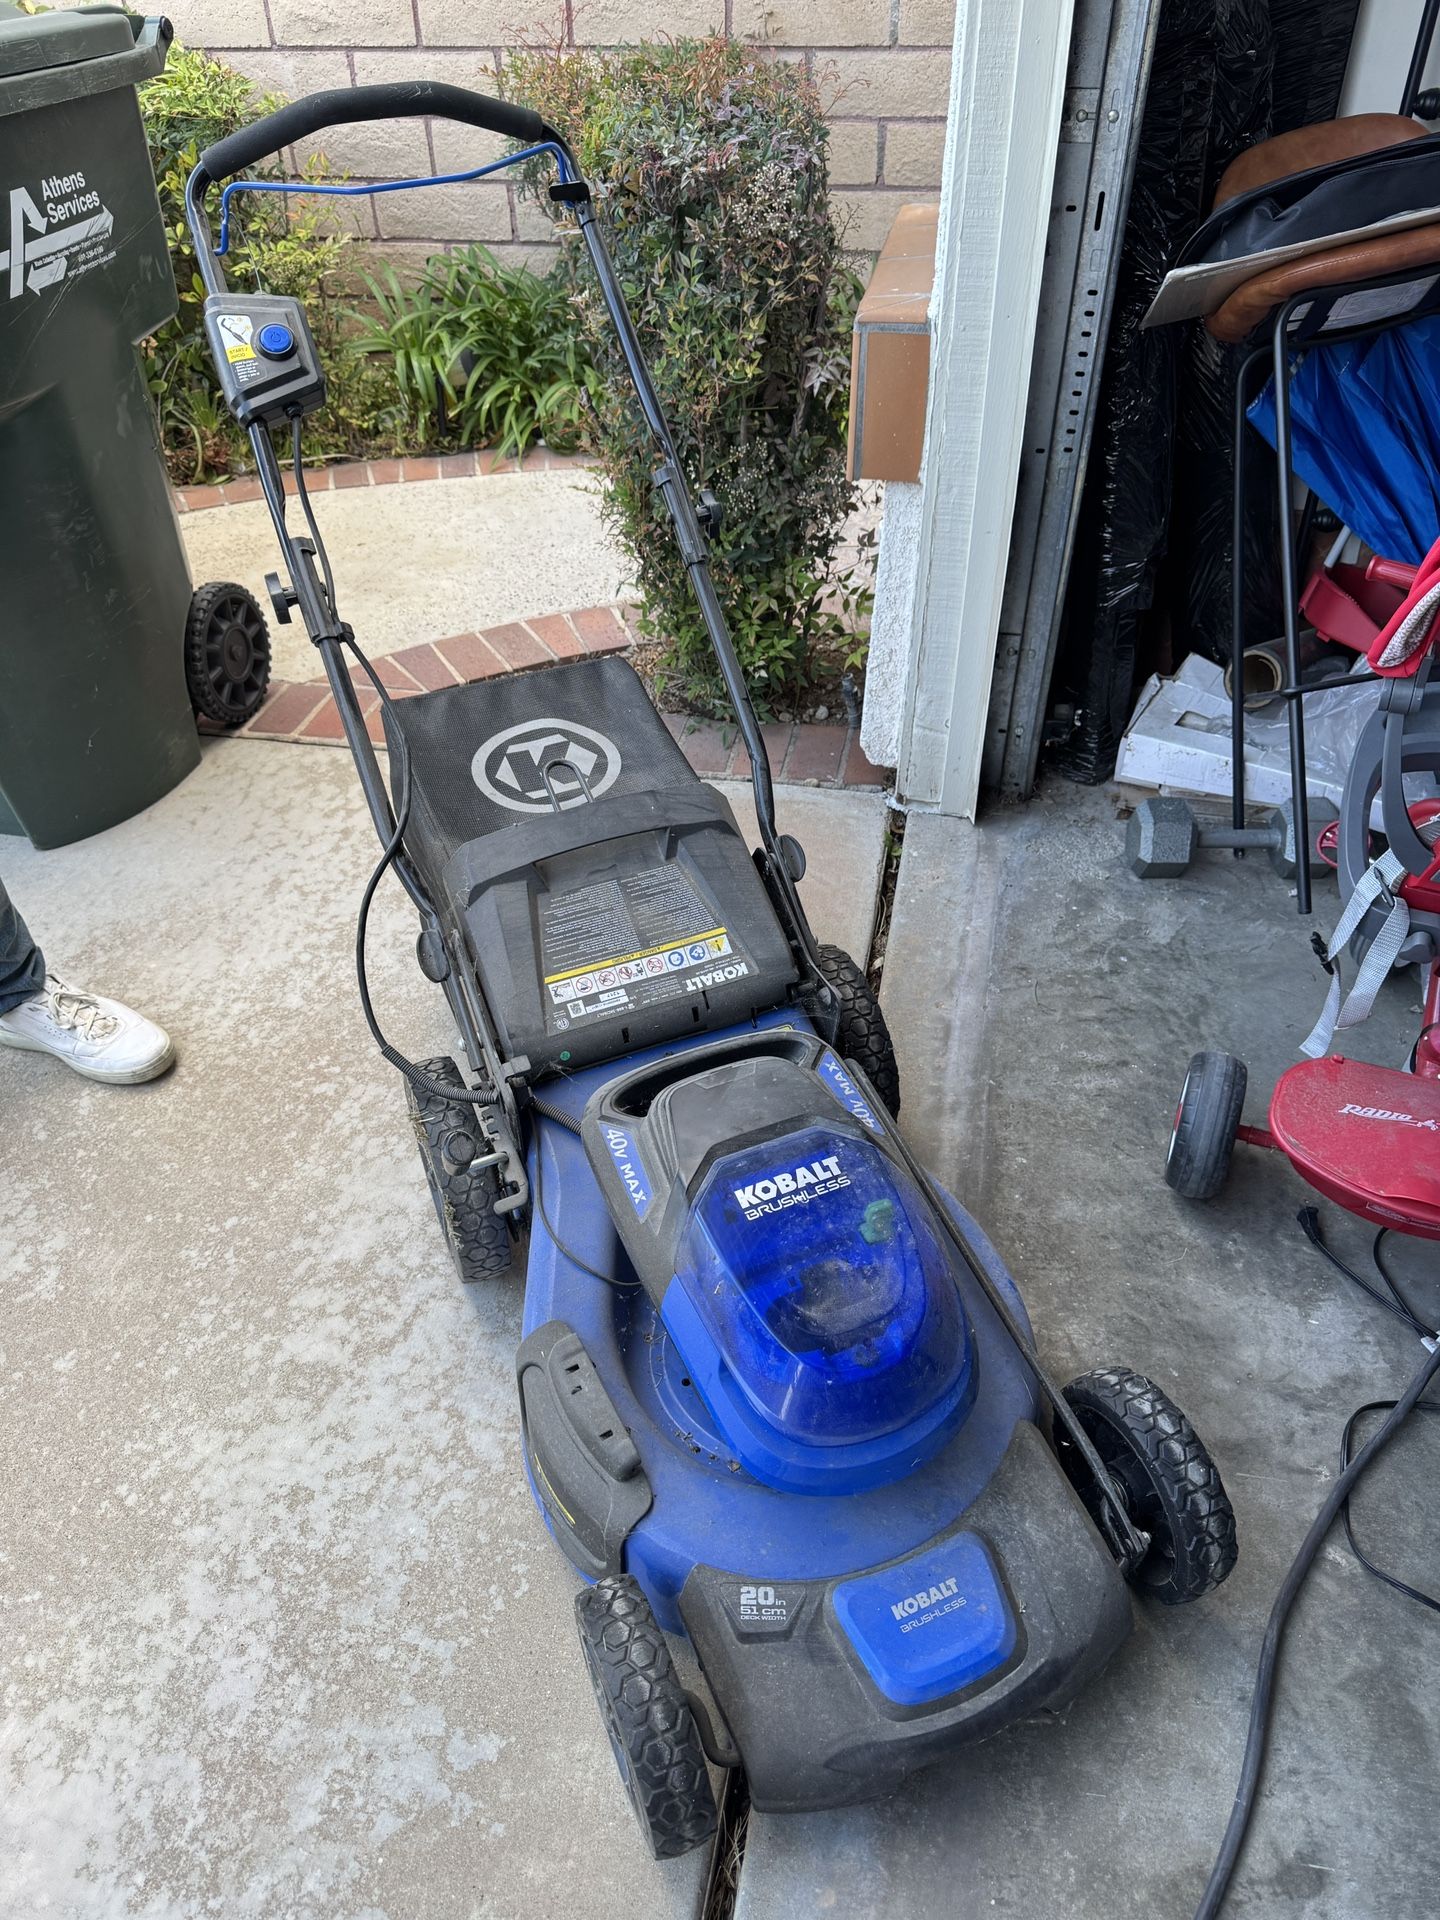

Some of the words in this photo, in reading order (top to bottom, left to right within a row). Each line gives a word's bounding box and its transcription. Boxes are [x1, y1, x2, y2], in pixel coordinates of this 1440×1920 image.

[41, 171, 86, 201] Athens
[46, 190, 100, 224] Services
[686, 962, 749, 992] KOBALT
[825, 1061, 855, 1095] MAX
[1338, 1103, 1412, 1122] RADIO
[620, 1163, 647, 1205] MAX
[734, 1155, 842, 1210] KOBALT
[744, 1175, 851, 1221] BRUSHLESS
[740, 1605, 758, 1615] 51
[761, 1607, 786, 1615] cm
[890, 1577, 959, 1621] KOBALT
[900, 1597, 967, 1634] BRUSHLESS
